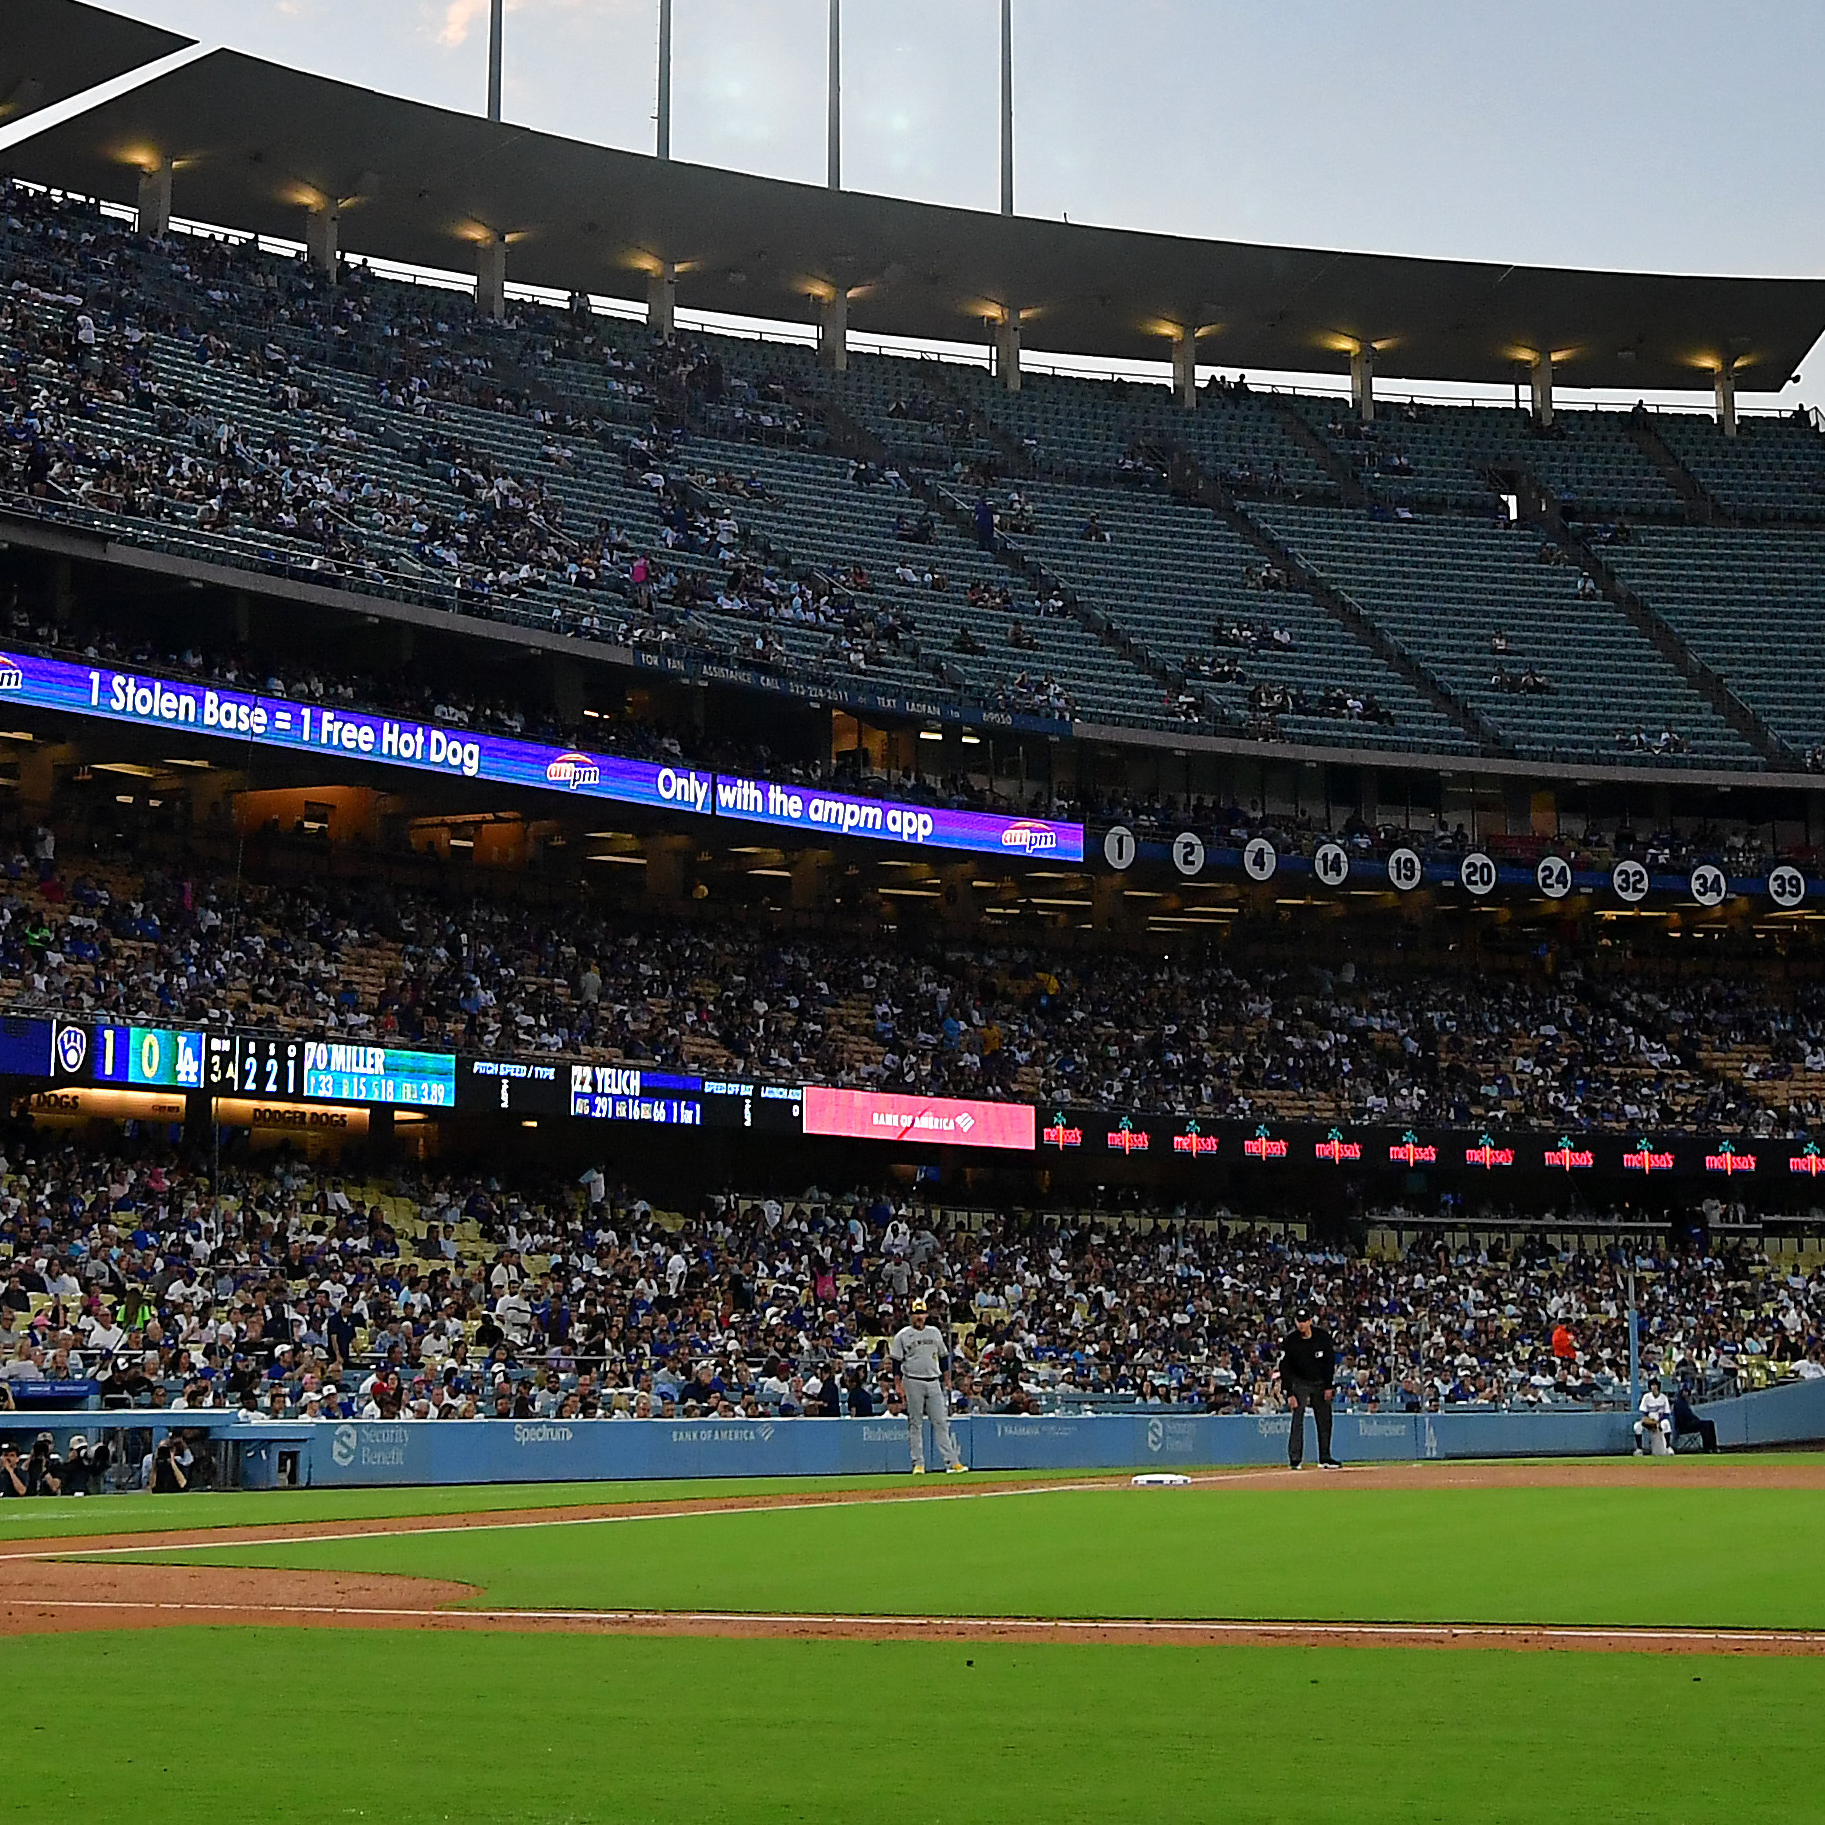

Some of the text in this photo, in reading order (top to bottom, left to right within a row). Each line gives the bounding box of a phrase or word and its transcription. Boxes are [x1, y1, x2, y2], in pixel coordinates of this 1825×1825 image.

[641, 654, 660, 668] FOR
[702, 665, 753, 683] ASSISTANCE
[760, 675, 781, 690] CALL
[874, 695, 898, 710] TEXT
[88, 671, 481, 778] 1 Stolen Base 1 Free Hot Dog
[545, 758, 601, 792] ampm
[656, 768, 934, 841] Only with the ampm app
[1001, 829, 1057, 854] ampm
[1116, 836, 1125, 861] 1
[1182, 841, 1195, 866] 2
[1251, 847, 1267, 871] 4
[1320, 853, 1342, 876] 14
[1393, 857, 1416, 881] 19
[1465, 862, 1493, 887] 20
[1540, 865, 1568, 890] 24
[1616, 869, 1645, 894] 32
[1694, 874, 1723, 899] 34
[1772, 874, 1802, 899] 39
[103, 1029, 160, 1079] 1 0
[329, 1043, 386, 1076] MILLER
[244, 1057, 278, 1093] 2 2
[473, 1061, 556, 1081] PITCH SPEED TYPE
[573, 1065, 641, 1096] 22 YELICH
[317, 1074, 444, 1105] 33 15 3.89
[679, 1102, 694, 1124] for
[872, 1112, 955, 1131] BANK AMERICA
[361, 1425, 410, 1445] Security
[512, 1423, 567, 1447] Spectrum
[672, 1427, 756, 1442] BANK AMERICA
[361, 1446, 405, 1465] Benefit
